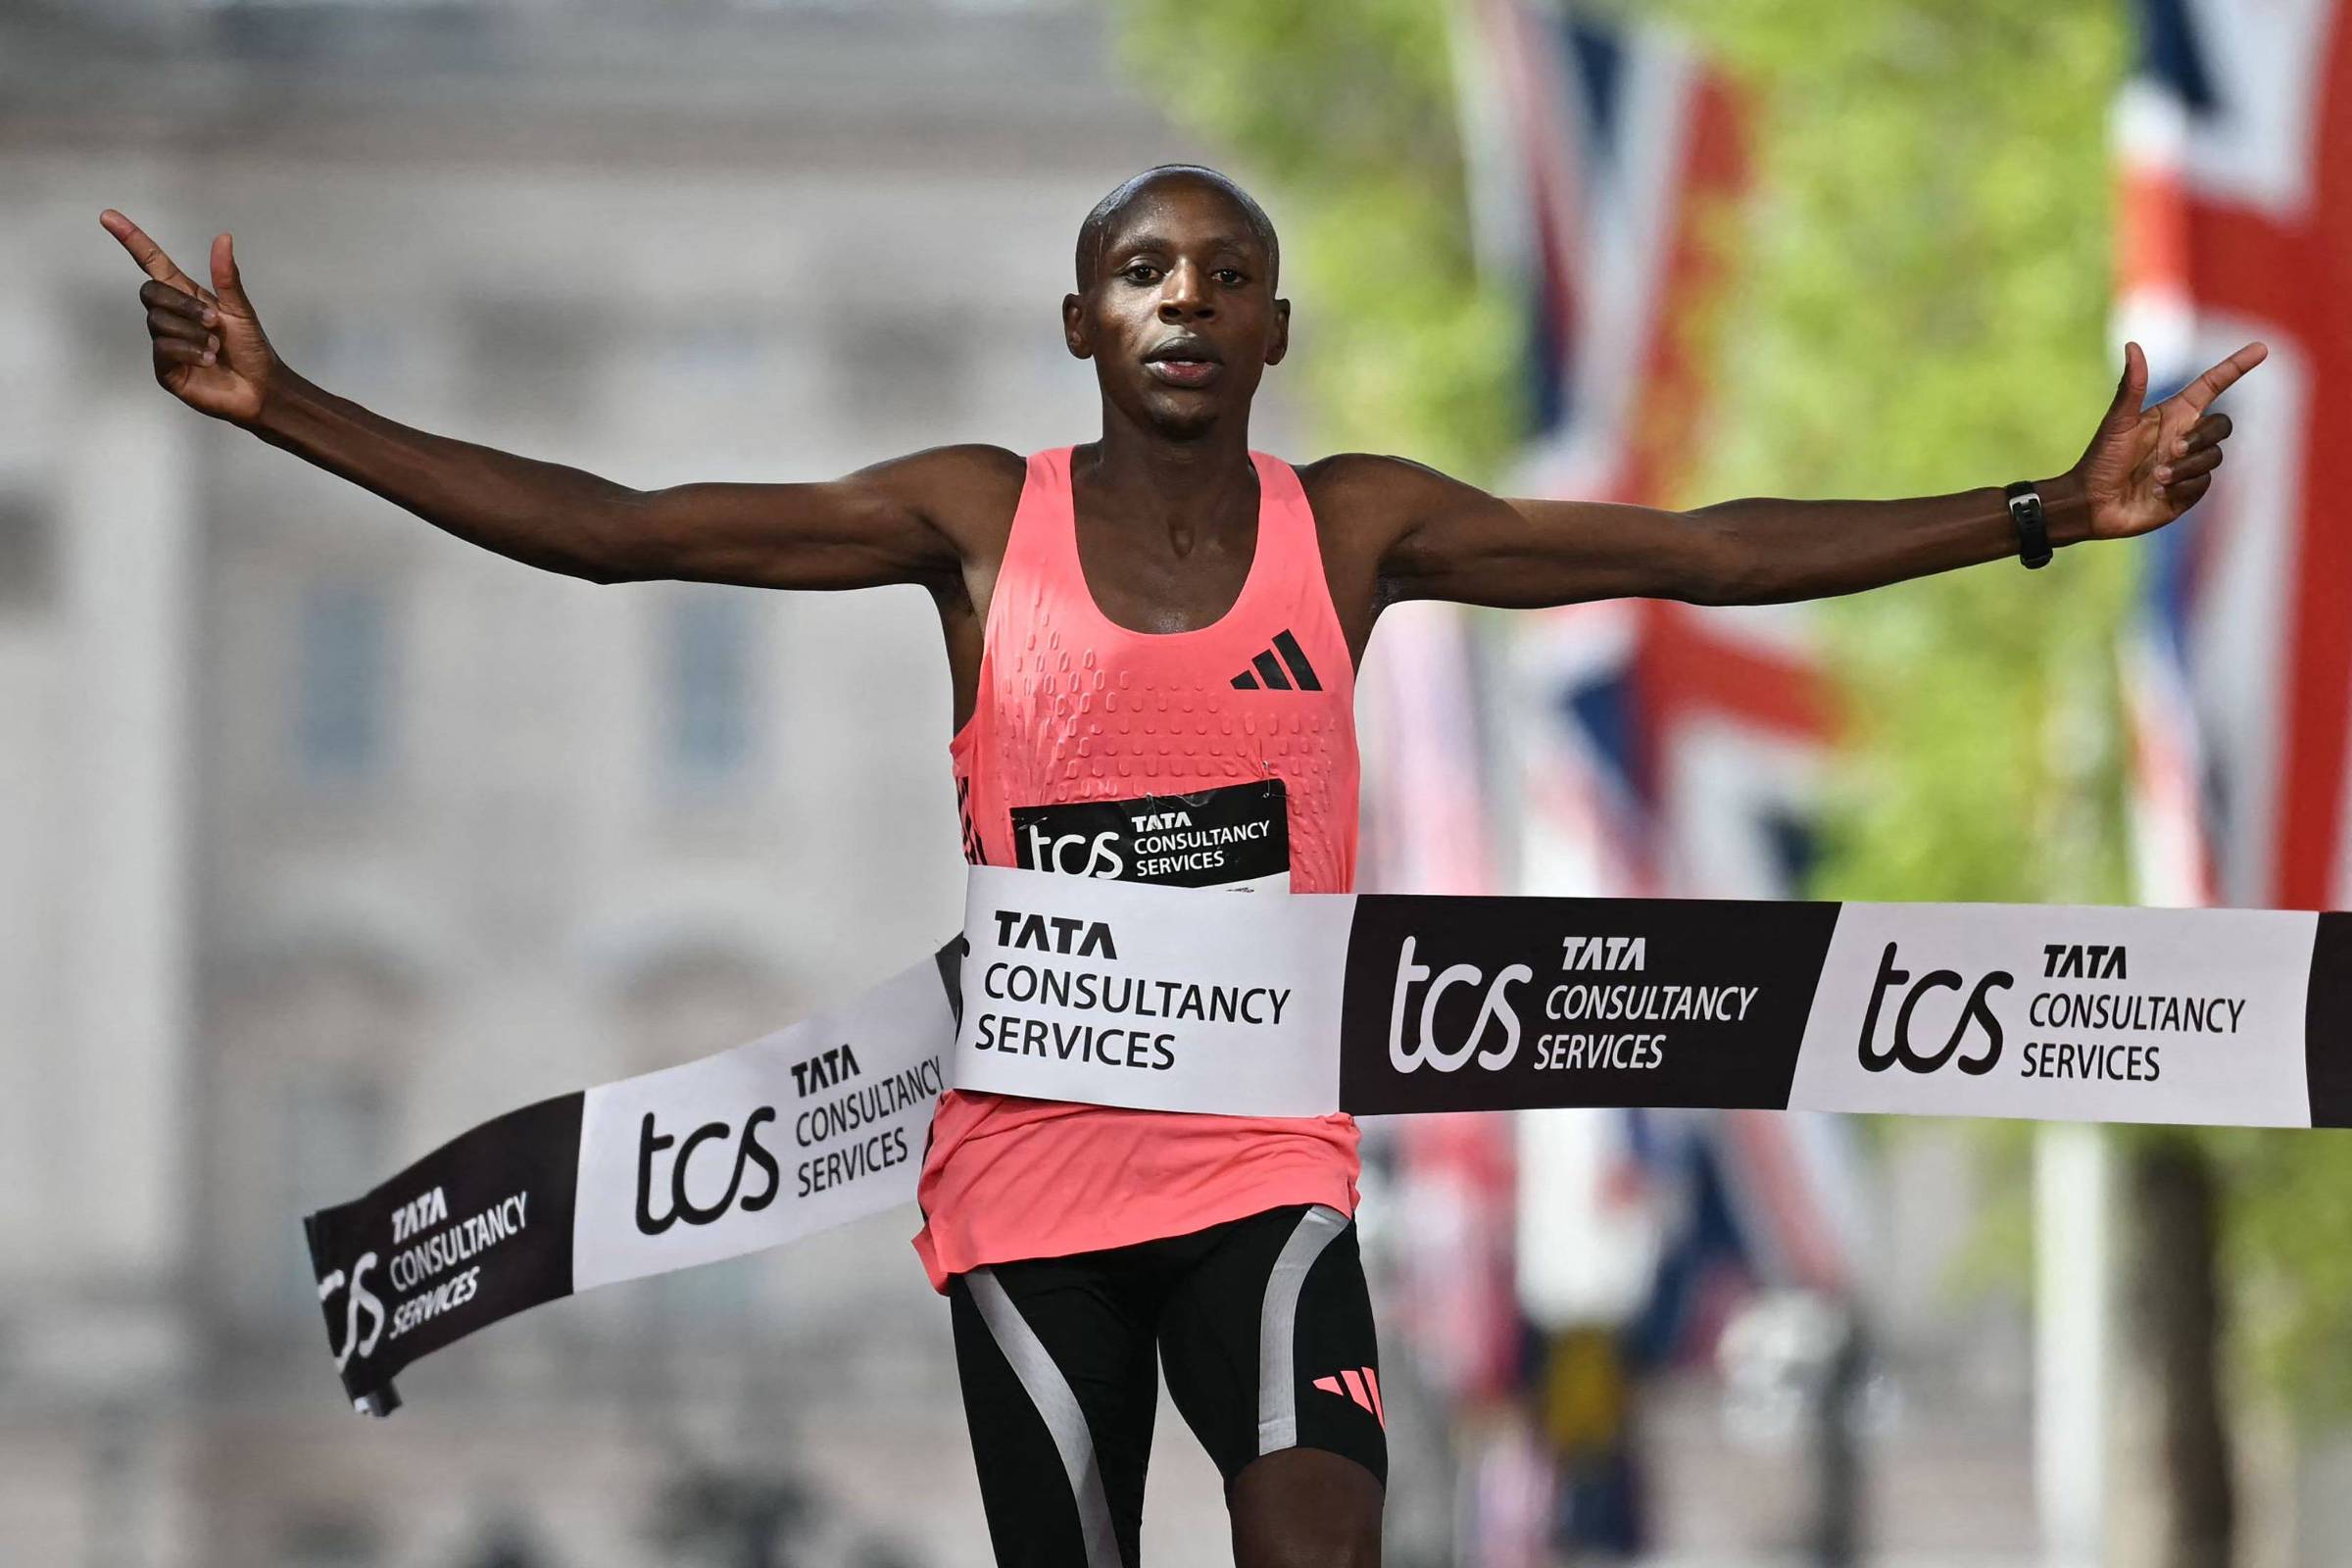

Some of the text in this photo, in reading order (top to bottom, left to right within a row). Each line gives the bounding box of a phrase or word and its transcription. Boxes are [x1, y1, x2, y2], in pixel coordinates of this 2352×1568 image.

[1131, 811, 1192, 833] TATA
[1134, 820, 1270, 855] CONSULTANCY
[1029, 824, 1123, 880] tcs
[1136, 851, 1224, 877] SERVICES
[994, 909, 1118, 960] TATA
[1561, 936, 1646, 971] TATA
[2042, 944, 2128, 980] TATA
[984, 961, 1292, 1025] CONSULTANCY
[1389, 935, 1533, 1074] tcs
[1545, 985, 1759, 1021] CONSULTANCY
[1857, 941, 2015, 1076] tcs
[2029, 992, 2246, 1034] CONSULTANCY
[974, 1012, 1176, 1070] SERVICES
[1533, 1034, 1666, 1070] SERVICES
[2020, 1042, 2161, 1083] SERVICES
[790, 1044, 860, 1099] TATA
[795, 1054, 946, 1148] CONSULTANCY
[634, 1105, 780, 1236] tcs
[797, 1126, 909, 1198] SERVICES
[390, 1190, 528, 1294] CONSULTANCY
[391, 1186, 449, 1245] TATA
[388, 1265, 481, 1341] SERVICES
